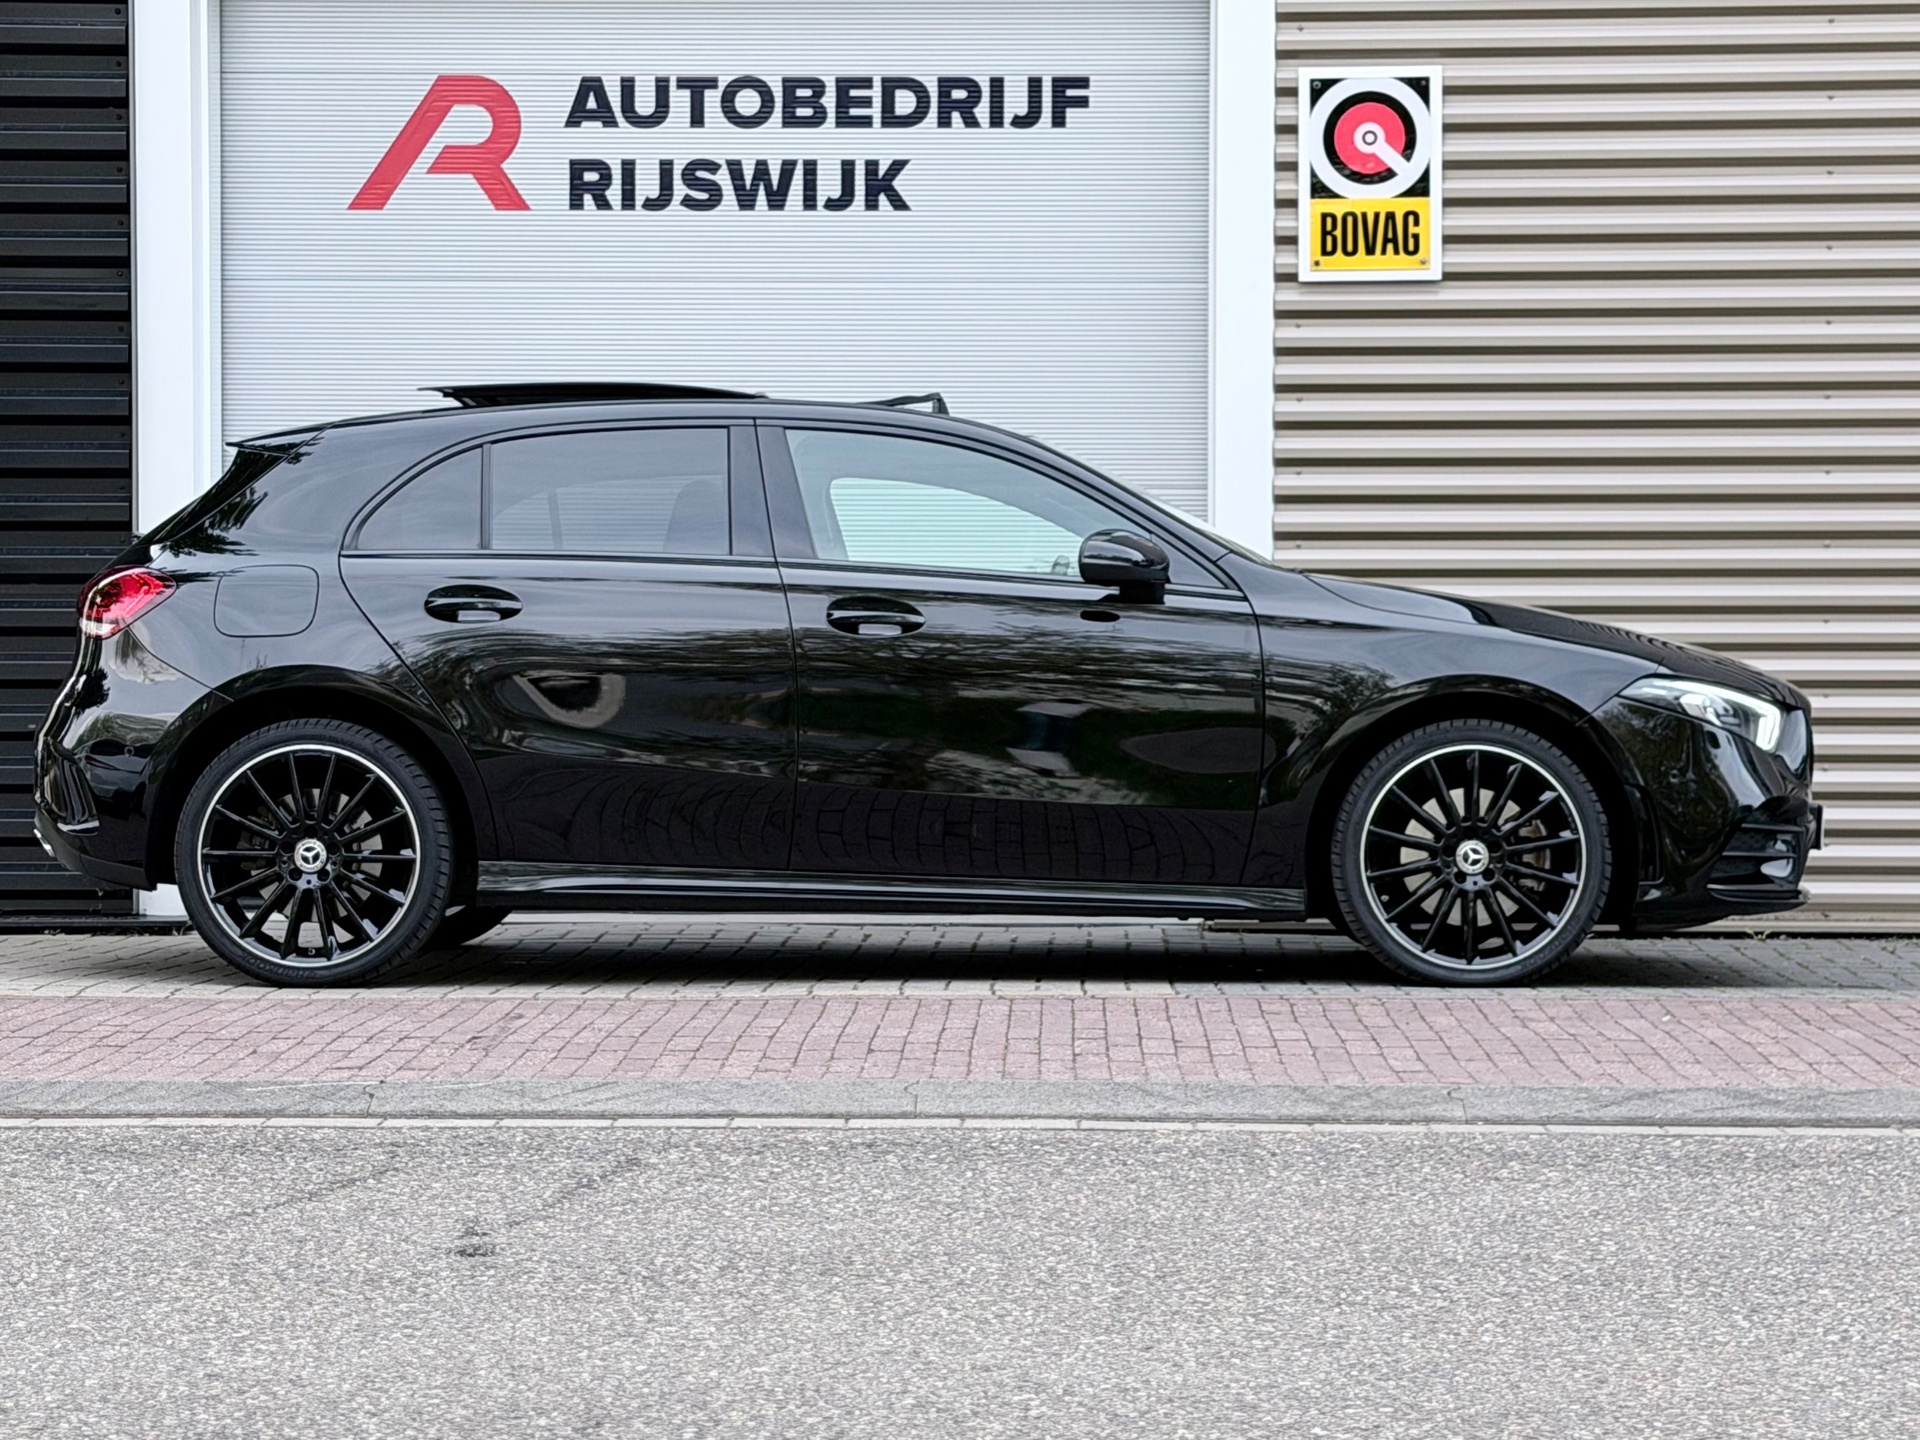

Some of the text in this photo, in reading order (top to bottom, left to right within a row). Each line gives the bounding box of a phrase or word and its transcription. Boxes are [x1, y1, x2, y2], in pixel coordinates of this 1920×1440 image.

[565, 75, 1090, 129] AUTOBEDRIJF
[569, 158, 911, 211] RIJSWIJK
[1320, 210, 1420, 257] BOVAG
